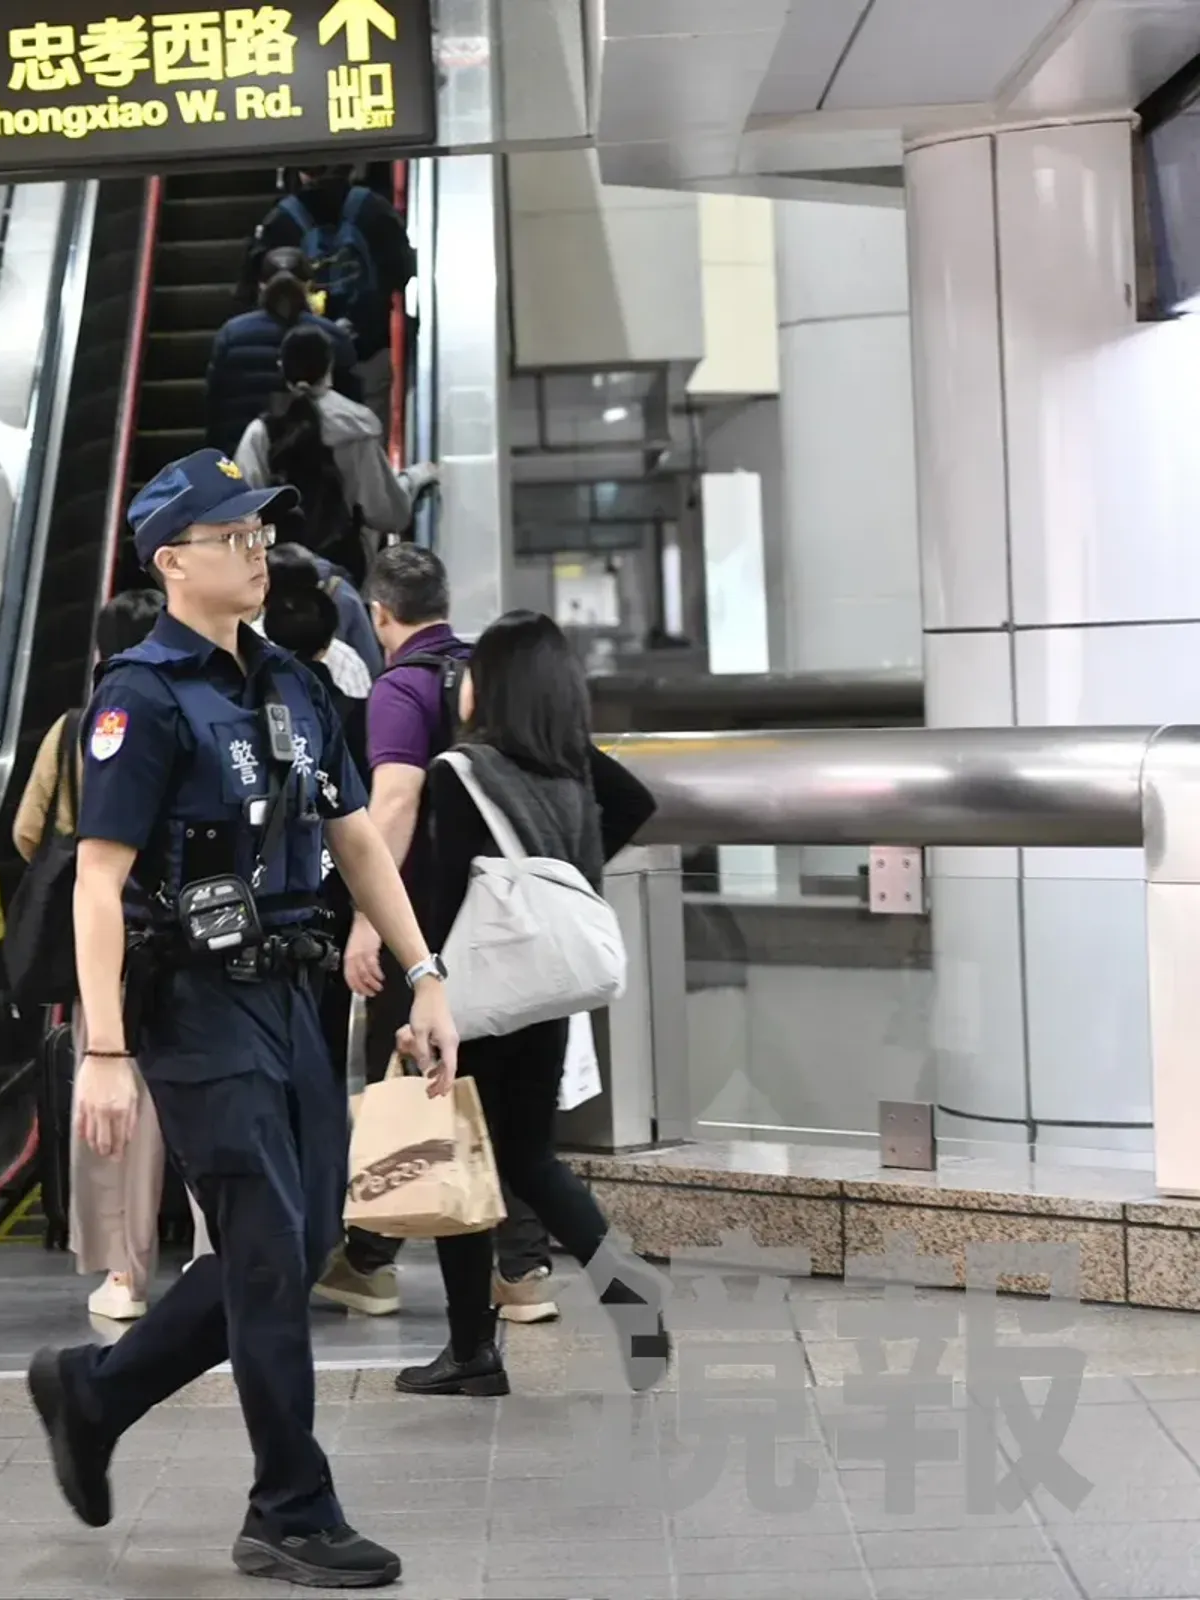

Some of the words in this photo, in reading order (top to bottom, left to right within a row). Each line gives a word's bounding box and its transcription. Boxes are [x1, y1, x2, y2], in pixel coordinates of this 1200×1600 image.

[8, 5, 298, 92] 忠孝西路
[175, 88, 226, 124] W.
[235, 84, 303, 121] Rd.
[327, 62, 394, 132] 出口
